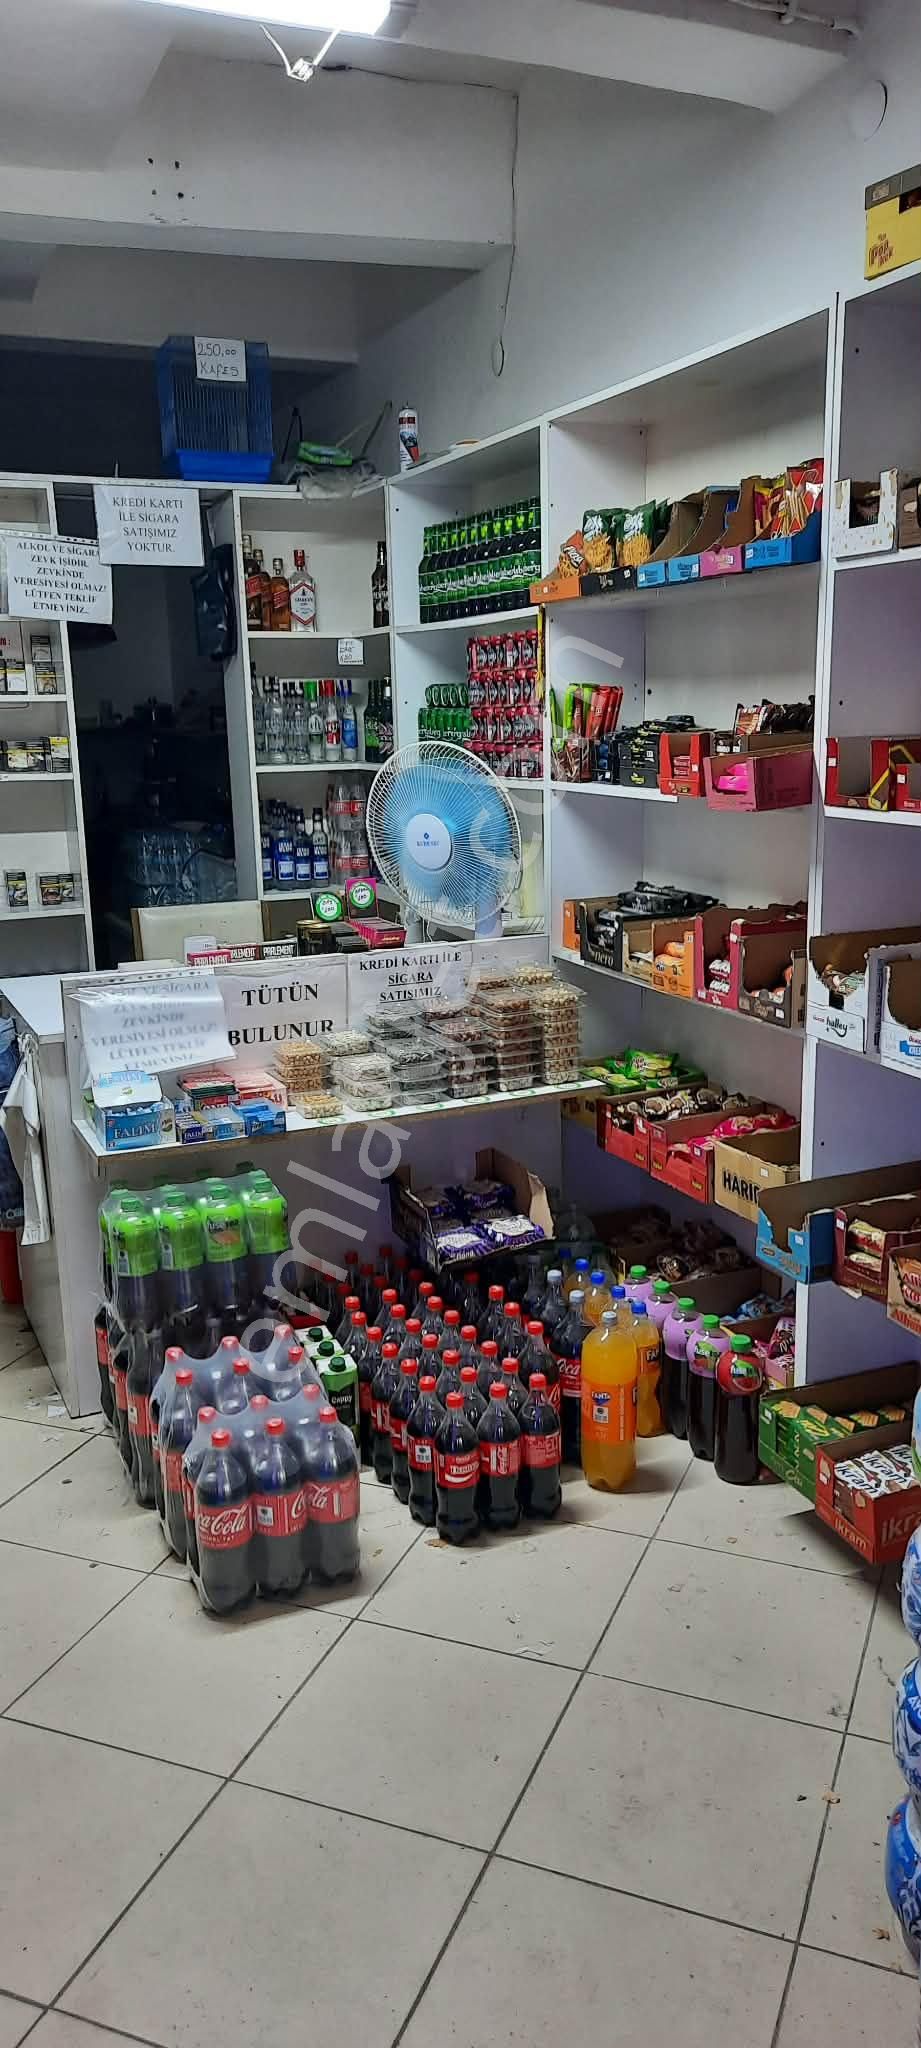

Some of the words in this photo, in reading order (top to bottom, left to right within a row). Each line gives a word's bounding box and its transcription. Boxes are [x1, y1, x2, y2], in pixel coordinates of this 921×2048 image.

[112, 496, 147, 508] KREDİ
[149, 498, 183, 509] KARTI
[118, 511, 137, 522] İLE
[138, 511, 179, 523] SİGARA
[123, 527, 177, 538] SATIŞIMIZ
[16, 542, 50, 553] ALKOL
[51, 545, 65, 554] VE
[127, 541, 175, 553] YOKTUR.
[31, 555, 57, 566] ZEVK
[36, 567, 85, 579] ZEVKİNDE
[24, 588, 62, 601] LÜTFEN
[359, 955, 399, 970] KREDİ
[401, 954, 440, 967] KARTI
[442, 951, 462, 963] İLE
[388, 971, 433, 985] SİGARA
[241, 982, 320, 1007] TÜTÜN
[826, 1016, 848, 1035] halley
[227, 1019, 334, 1046] BULUNUR
[331, 1394, 353, 1405] Cappy
[862, 1453, 907, 1484] ikram
[837, 1464, 880, 1495] ikram
[834, 1517, 867, 1550] ikram
